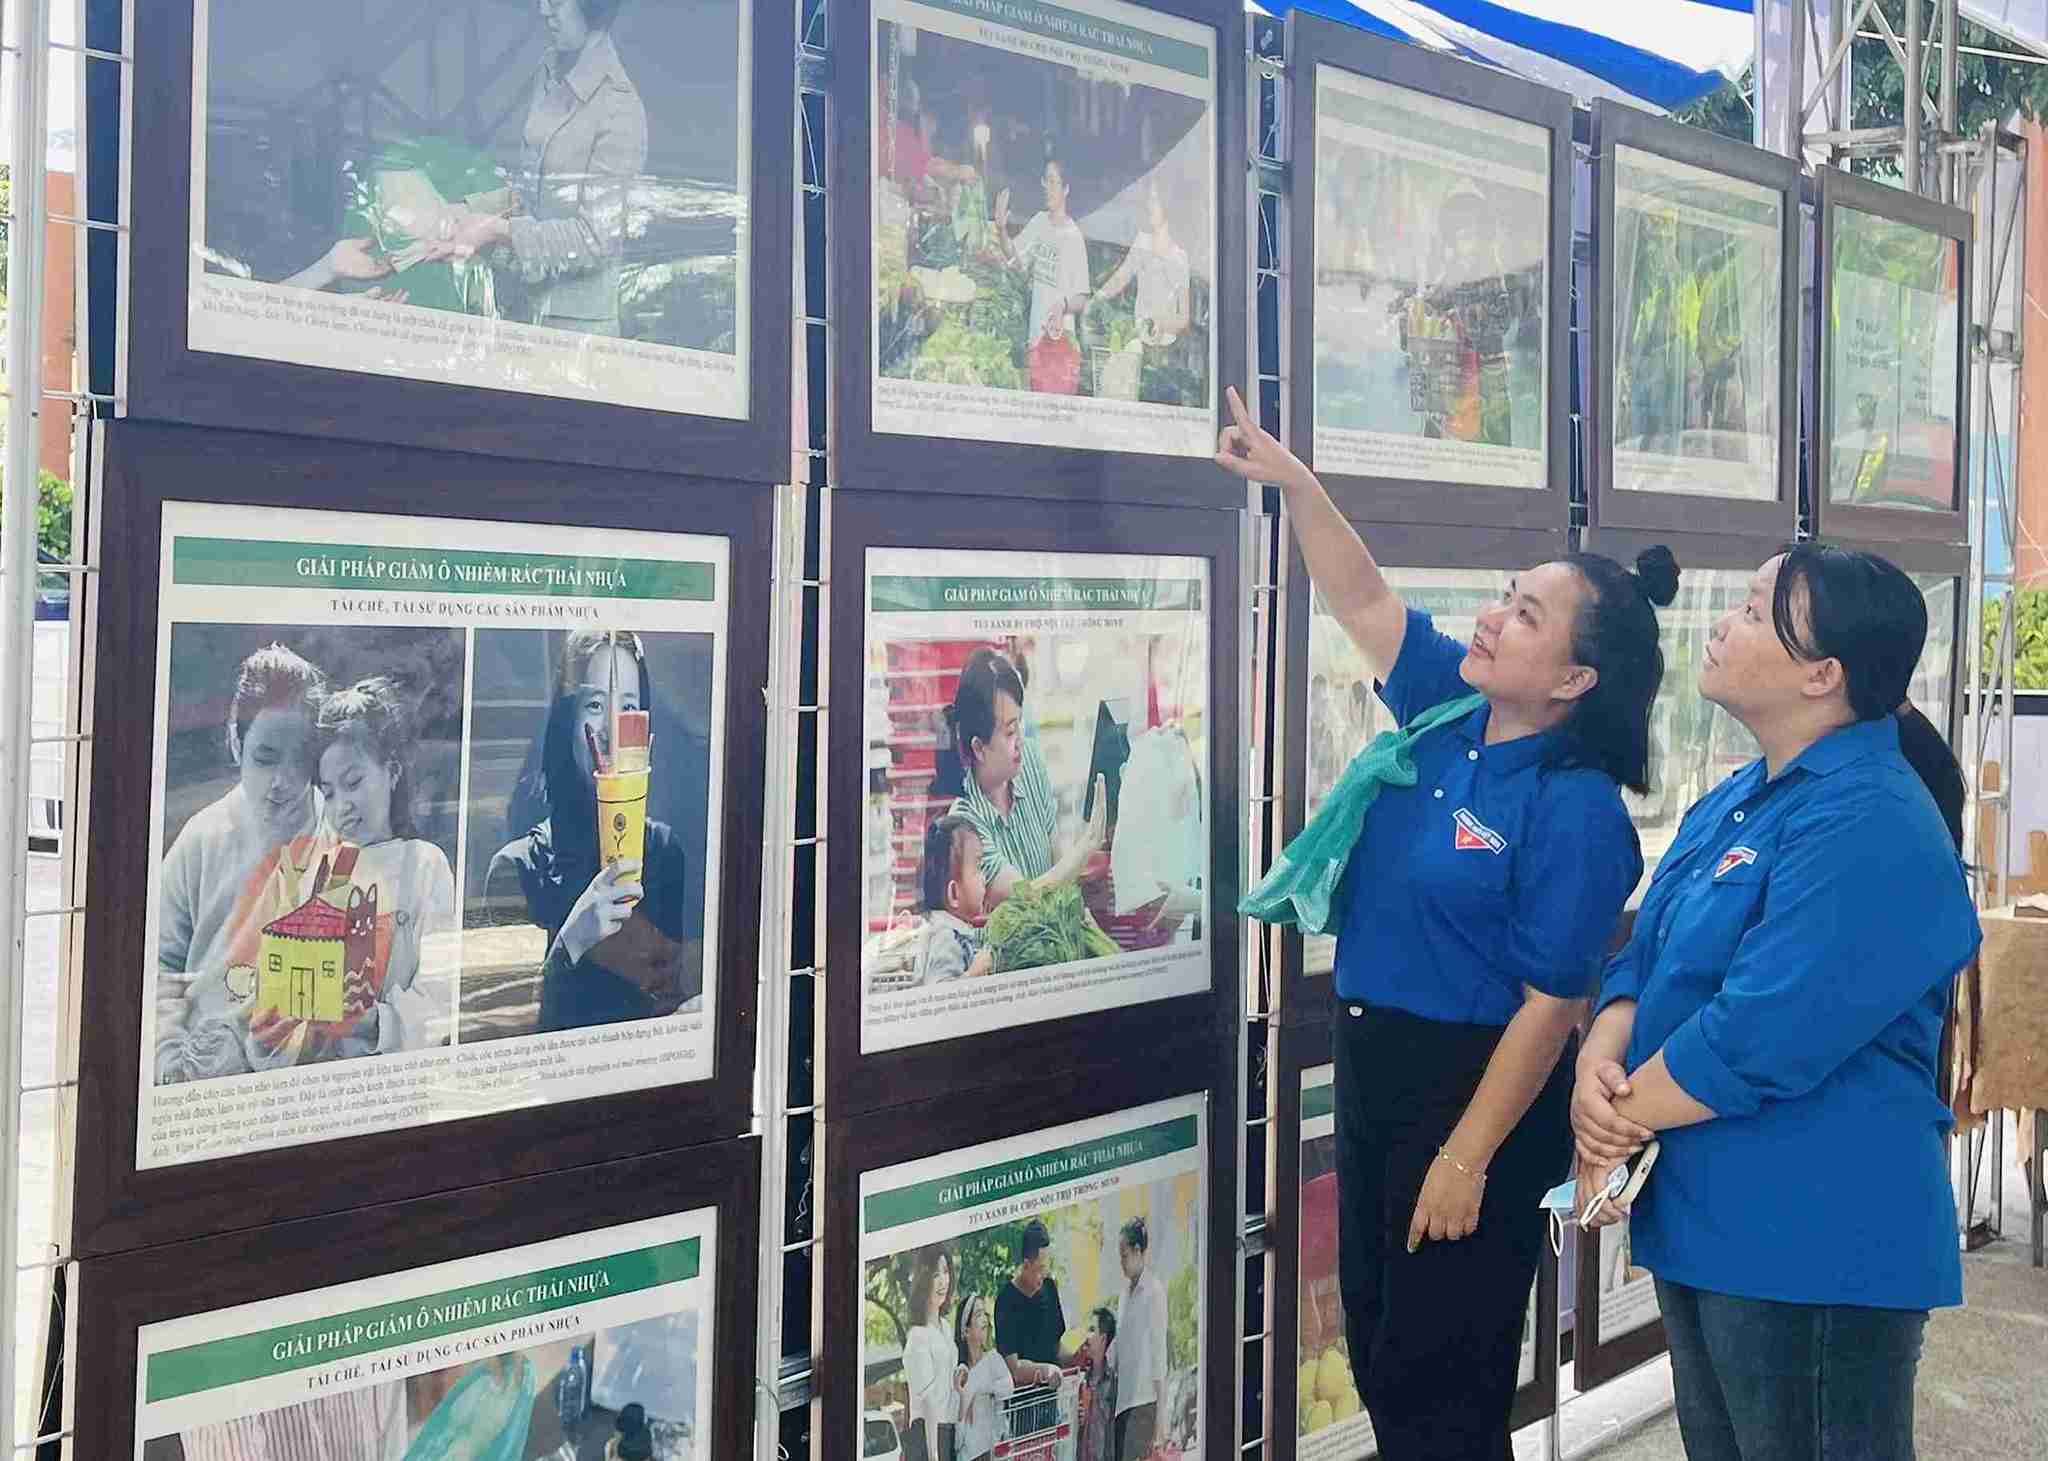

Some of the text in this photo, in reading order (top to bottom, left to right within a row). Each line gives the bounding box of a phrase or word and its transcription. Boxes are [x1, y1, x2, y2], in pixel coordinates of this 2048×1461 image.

[297, 554, 336, 577] GIẢI
[341, 556, 386, 579] PHÁP
[388, 557, 434, 580] GIẢM
[438, 559, 451, 581] Ô
[510, 563, 544, 584] RÁC
[545, 565, 582, 586] THẢI
[585, 568, 627, 590] NHỰA
[965, 1175, 994, 1198] PHÁP
[1024, 1163, 1034, 1181] Ô
[272, 1269, 611, 1361] GIẢI PHÁP GIẢM Ô NHIỄM RÁC THẢI NHỰA
